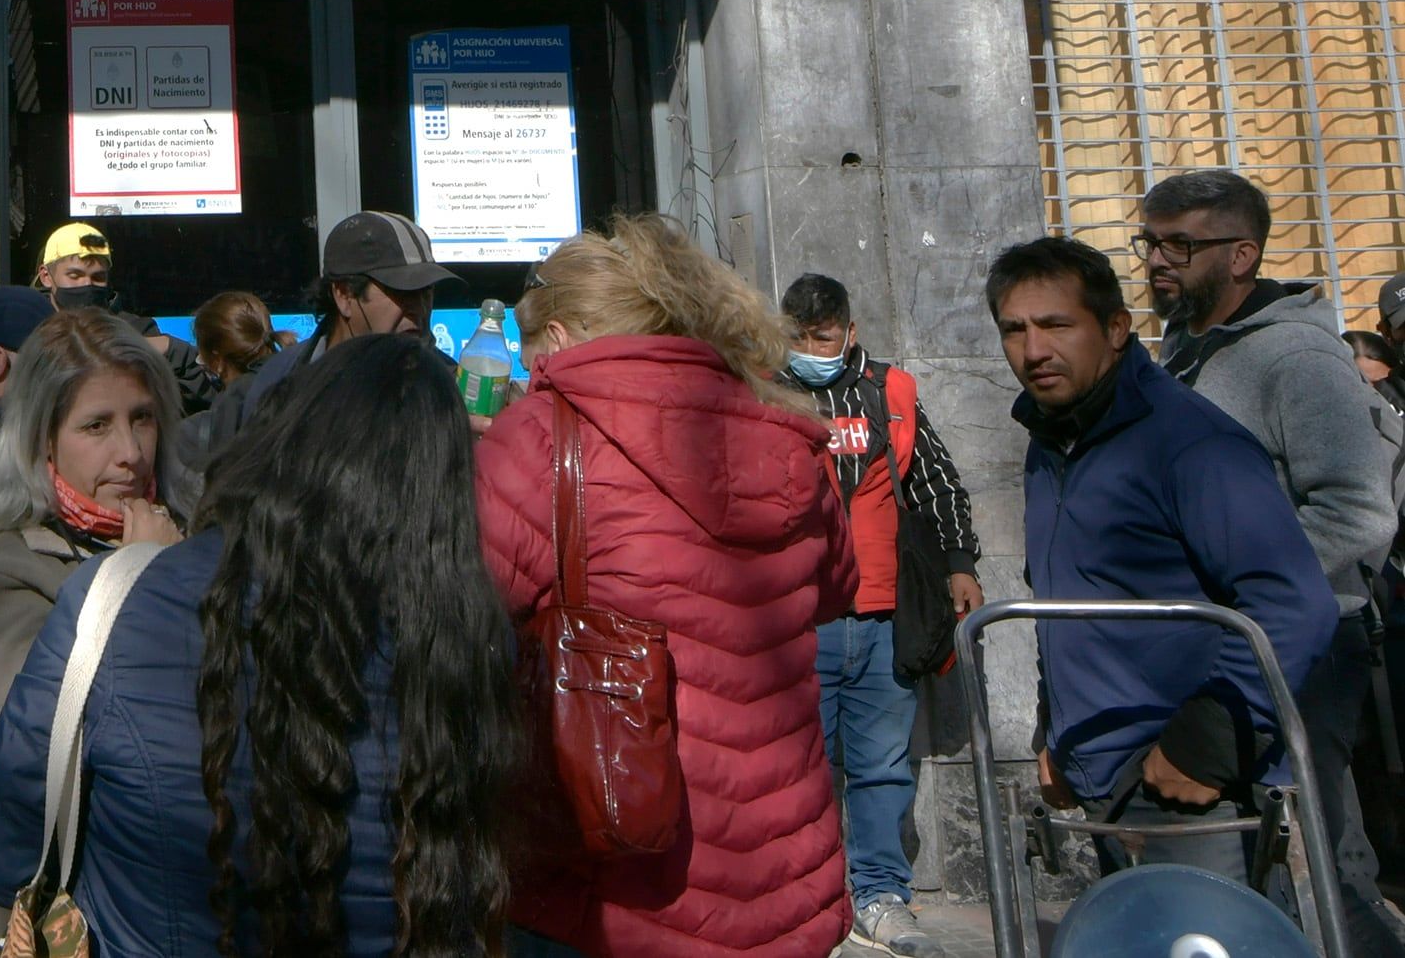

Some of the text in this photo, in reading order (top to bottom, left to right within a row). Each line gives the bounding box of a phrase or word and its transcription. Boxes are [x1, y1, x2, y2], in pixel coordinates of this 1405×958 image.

[113, 1, 156, 10] POR HIJO
[453, 37, 564, 47] ASIGNACIÓN UNIVERSAL
[453, 49, 496, 58] POR HIJO
[153, 75, 204, 85] Partidas de
[451, 79, 489, 91] Averigüe
[500, 79, 517, 89] está
[520, 79, 562, 91] registrado
[95, 87, 132, 105] DNI
[153, 88, 206, 97] Nacimiento
[95, 129, 104, 137] Es
[106, 128, 161, 138] indispensable
[462, 128, 547, 141] Mensaje al 26737
[100, 140, 115, 148] DNI
[123, 139, 156, 149] partidas
[158, 139, 168, 147] de
[104, 150, 150, 160] (originales
[161, 150, 211, 158] fotocopias)
[107, 161, 117, 169] de
[119, 161, 139, 170] todo
[140, 160, 148, 169] el
[150, 161, 174, 170] grupo
